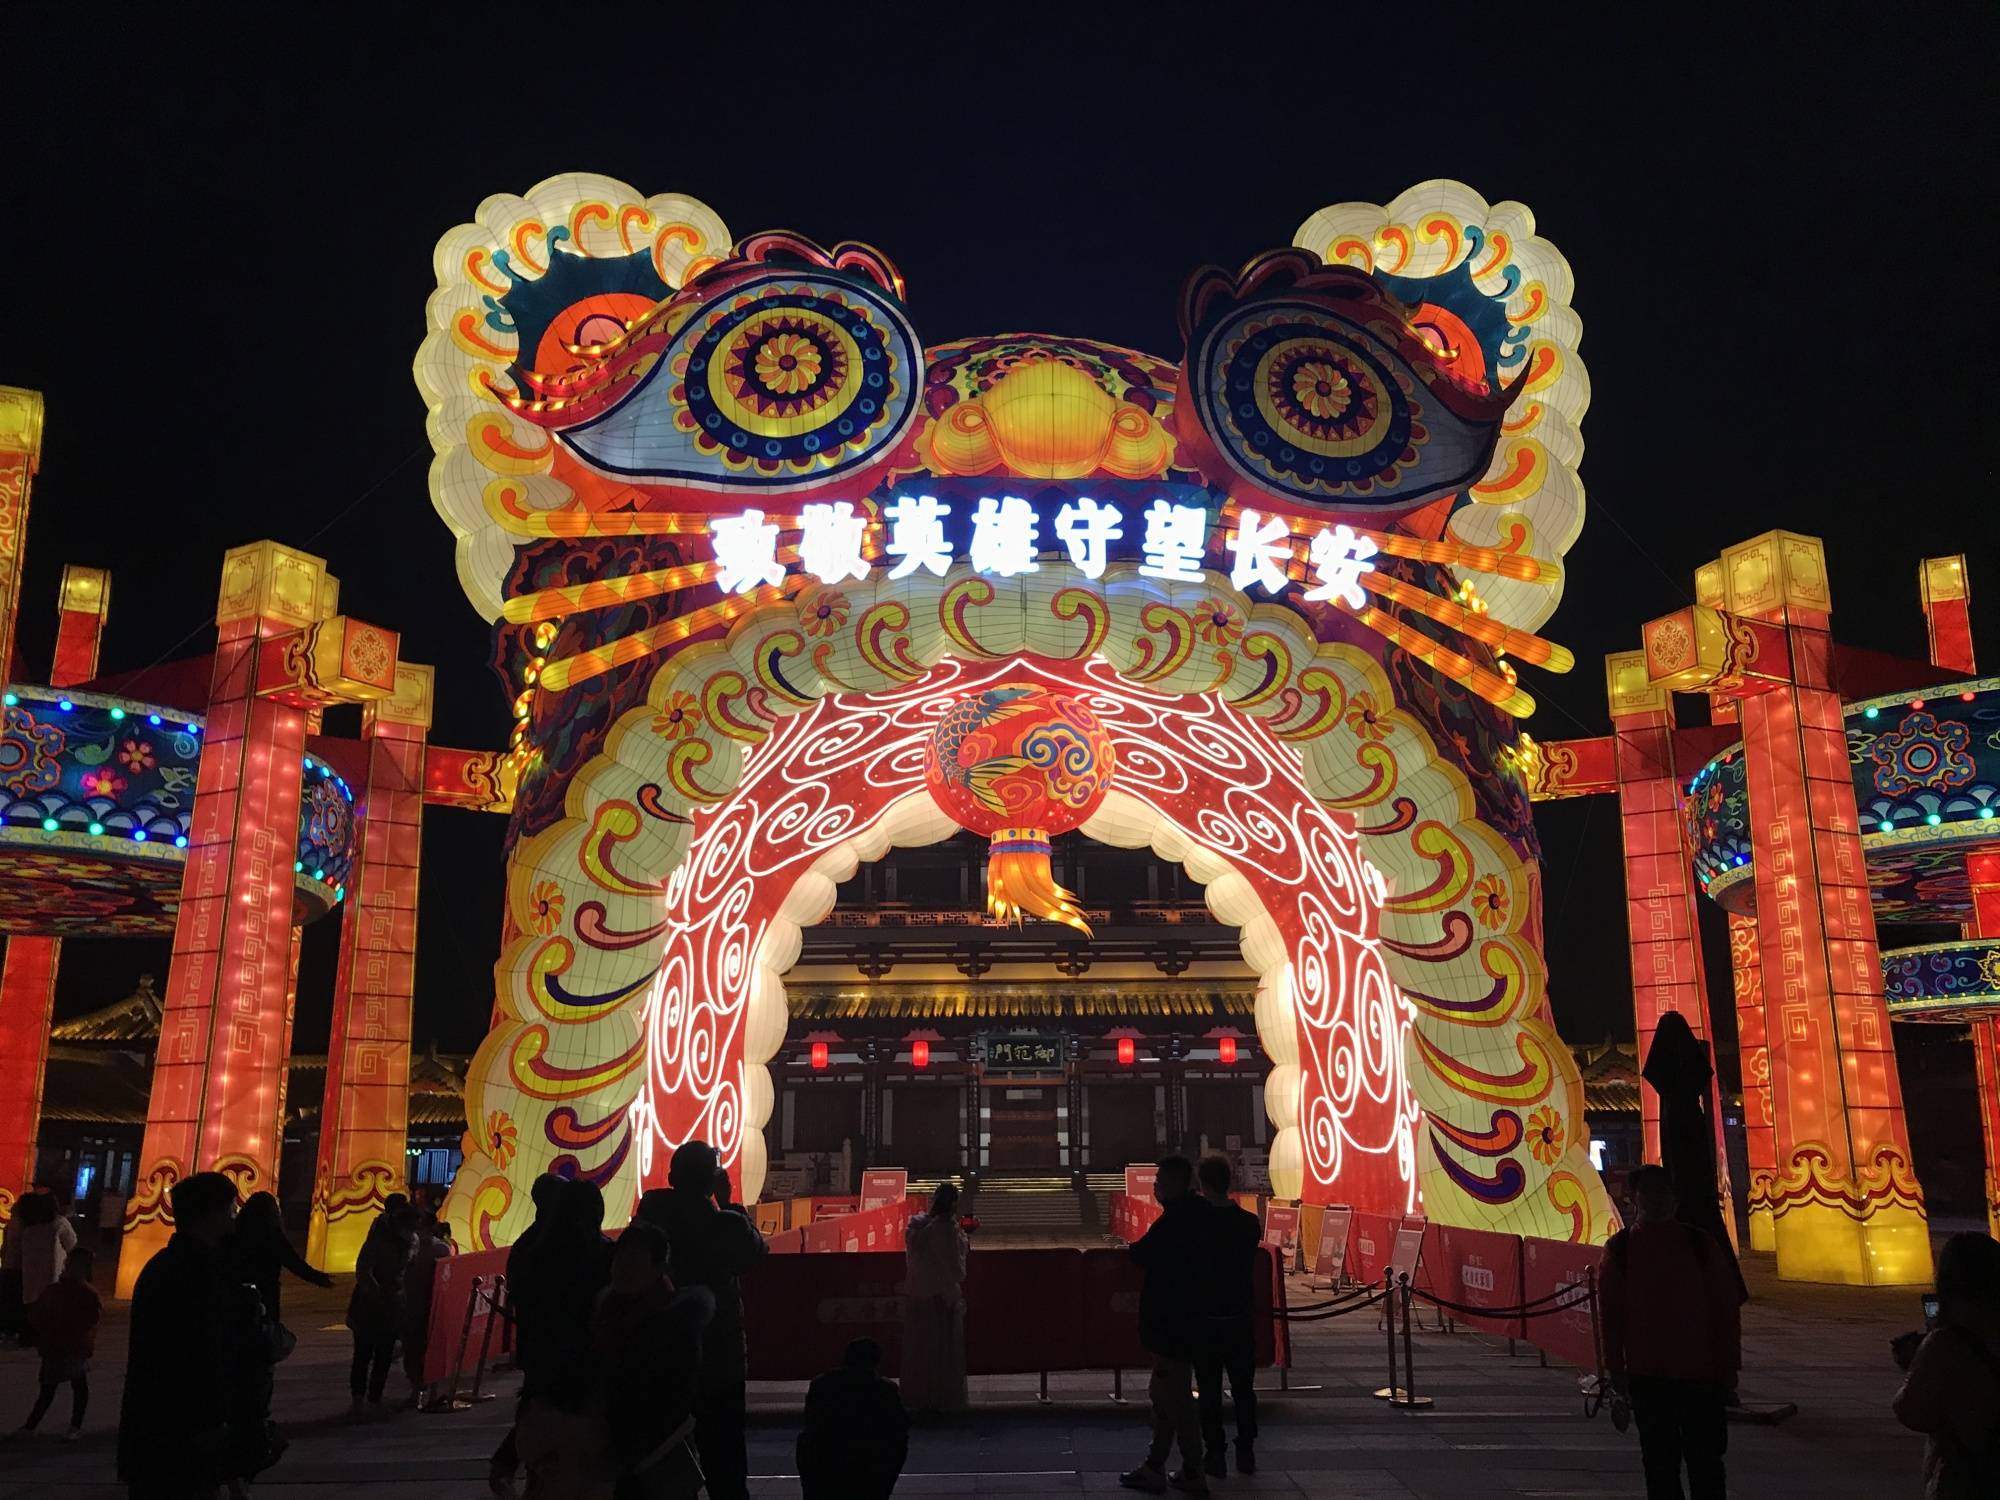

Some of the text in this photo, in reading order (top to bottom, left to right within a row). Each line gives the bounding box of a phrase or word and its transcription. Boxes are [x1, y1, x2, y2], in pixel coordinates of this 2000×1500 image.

[710, 496, 1378, 609] 致敬英雄守望长安
